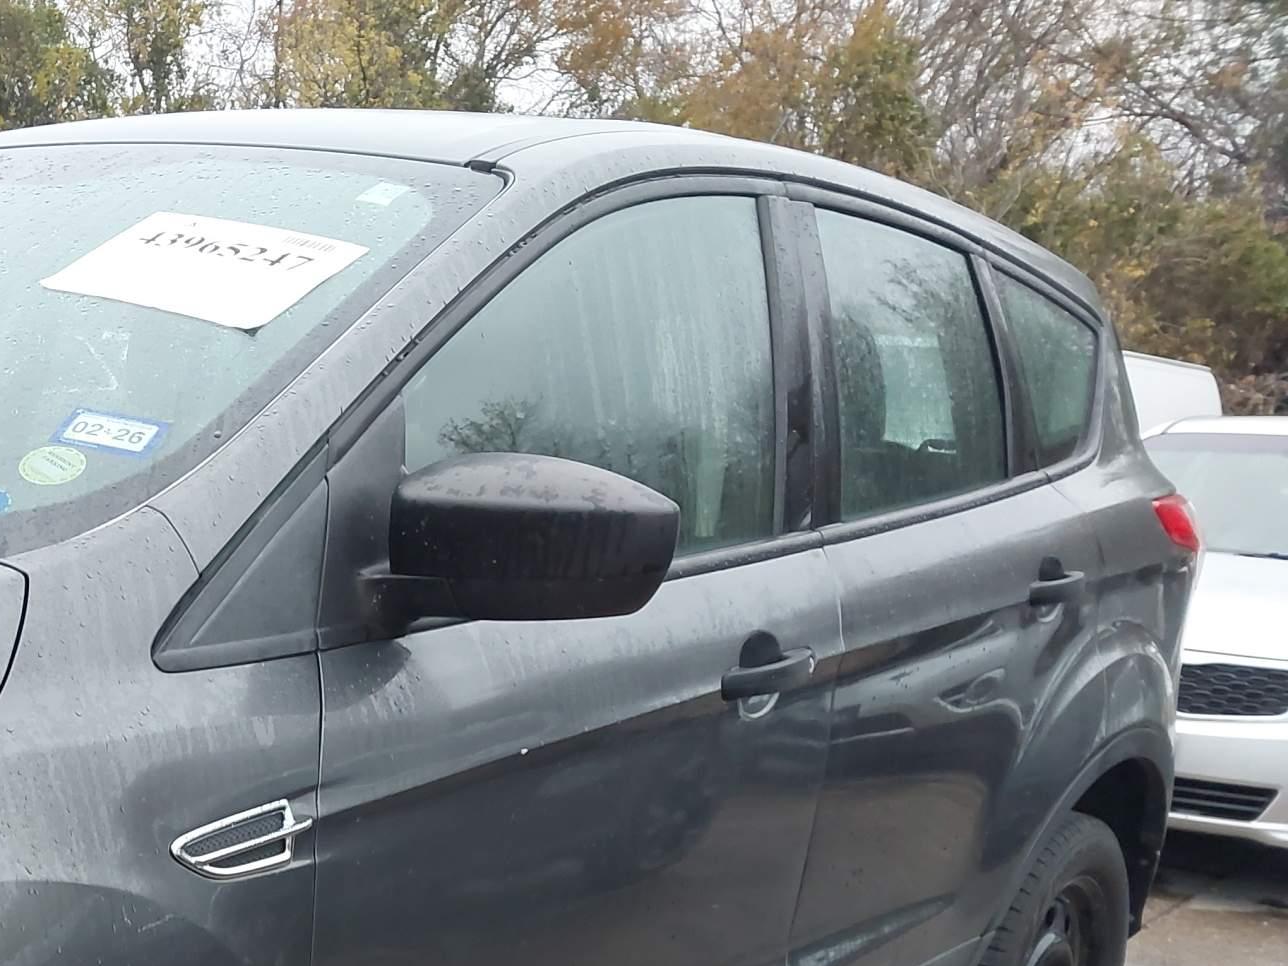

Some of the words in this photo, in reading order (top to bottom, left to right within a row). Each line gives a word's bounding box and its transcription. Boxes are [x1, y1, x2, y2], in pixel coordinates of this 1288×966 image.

[139, 231, 315, 271] 43965247
[72, 420, 104, 437] 02
[112, 428, 146, 445] 26
